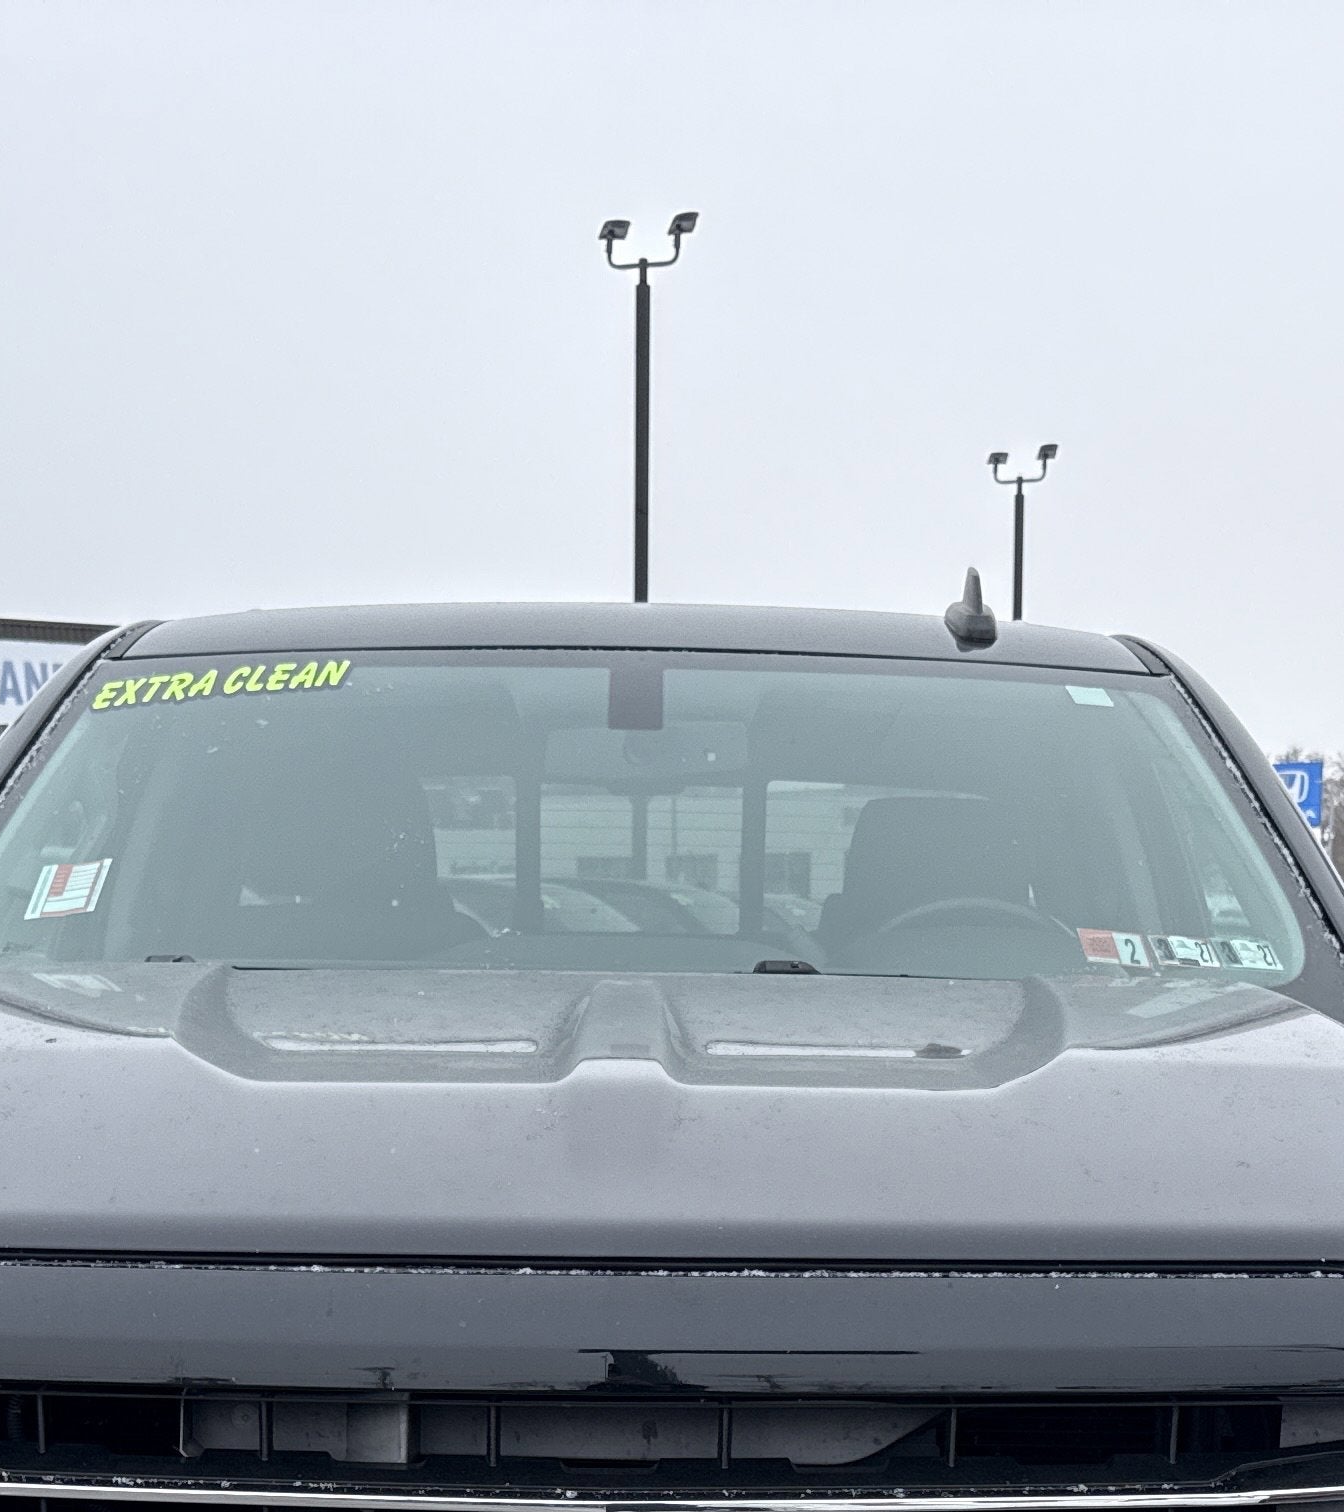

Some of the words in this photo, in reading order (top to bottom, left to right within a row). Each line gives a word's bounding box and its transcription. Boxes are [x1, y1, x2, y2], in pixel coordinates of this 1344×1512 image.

[92, 669, 218, 710] EXTRA
[223, 660, 351, 695] CLEAN
[1124, 938, 1142, 966] 2
